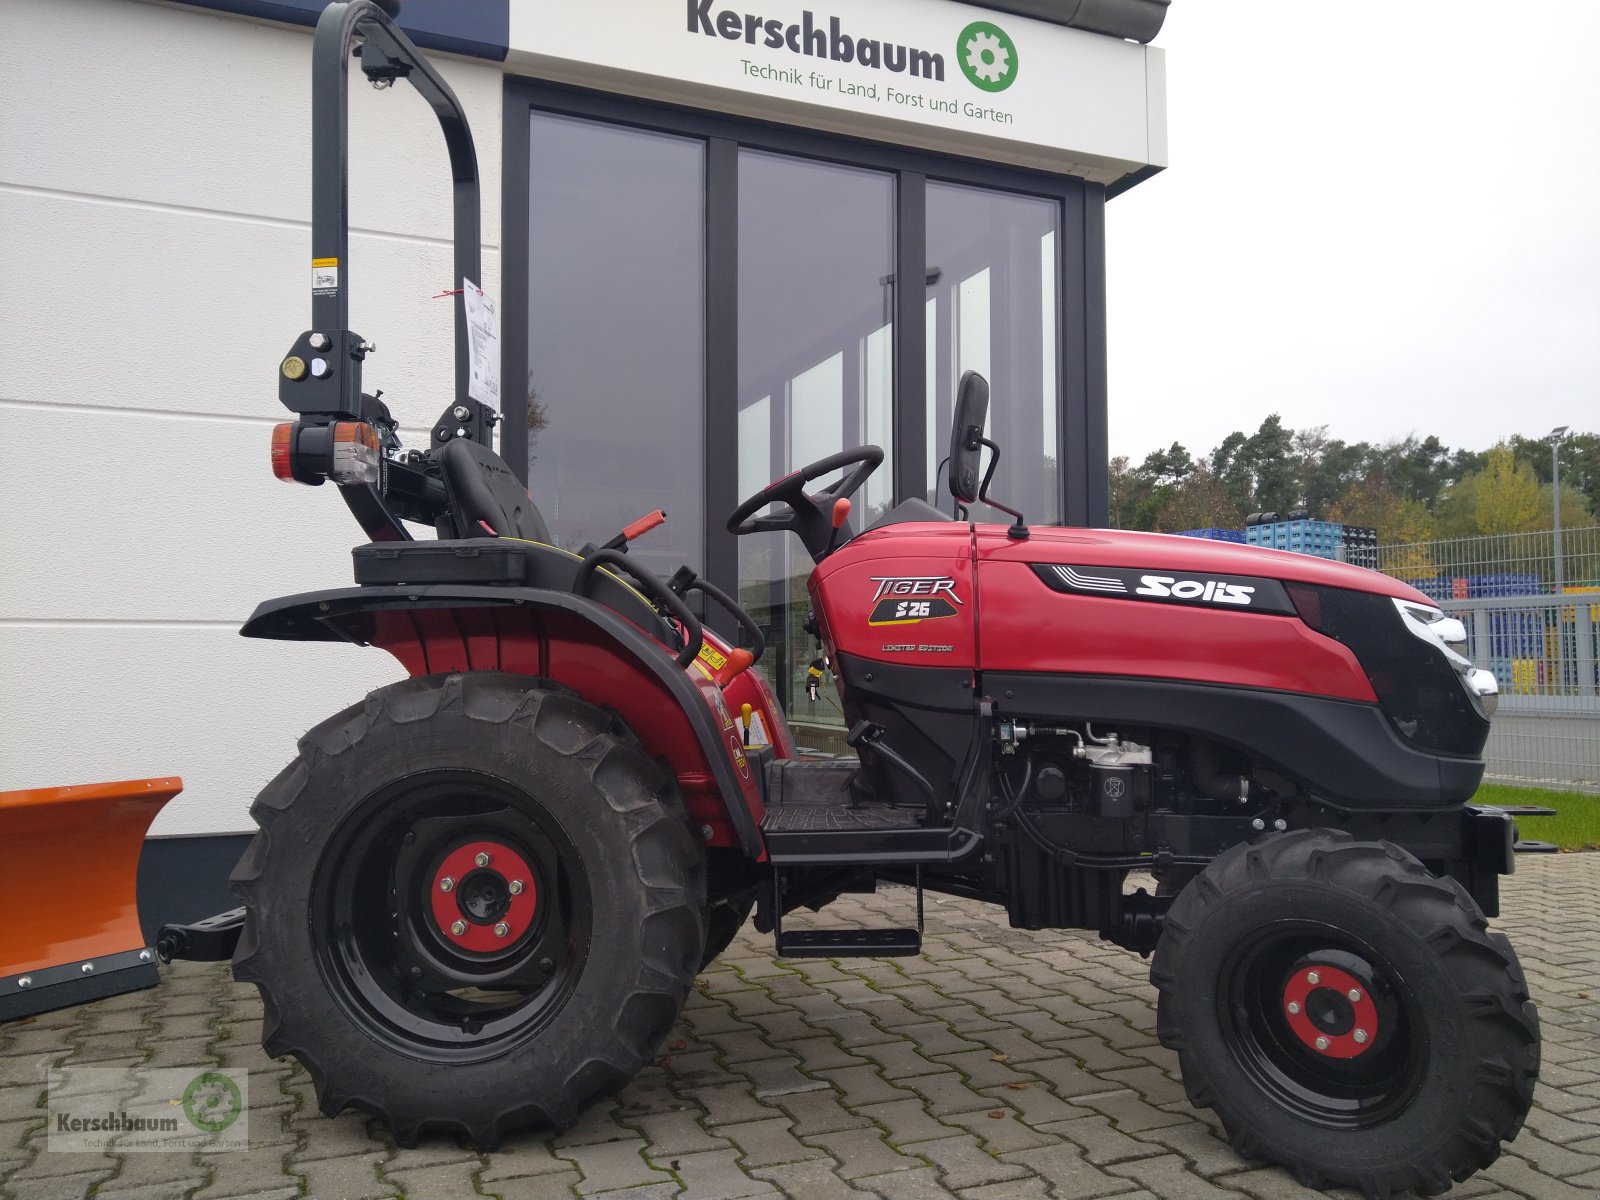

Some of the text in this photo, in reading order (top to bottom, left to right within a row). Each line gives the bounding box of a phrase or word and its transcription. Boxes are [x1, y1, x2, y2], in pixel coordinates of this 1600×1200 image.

[687, 0, 945, 82] Kerschbaum
[740, 59, 1013, 125] Technik für Land, Forst und Garten
[869, 576, 964, 604] TIGER
[881, 644, 953, 653] LIMITED EDITION
